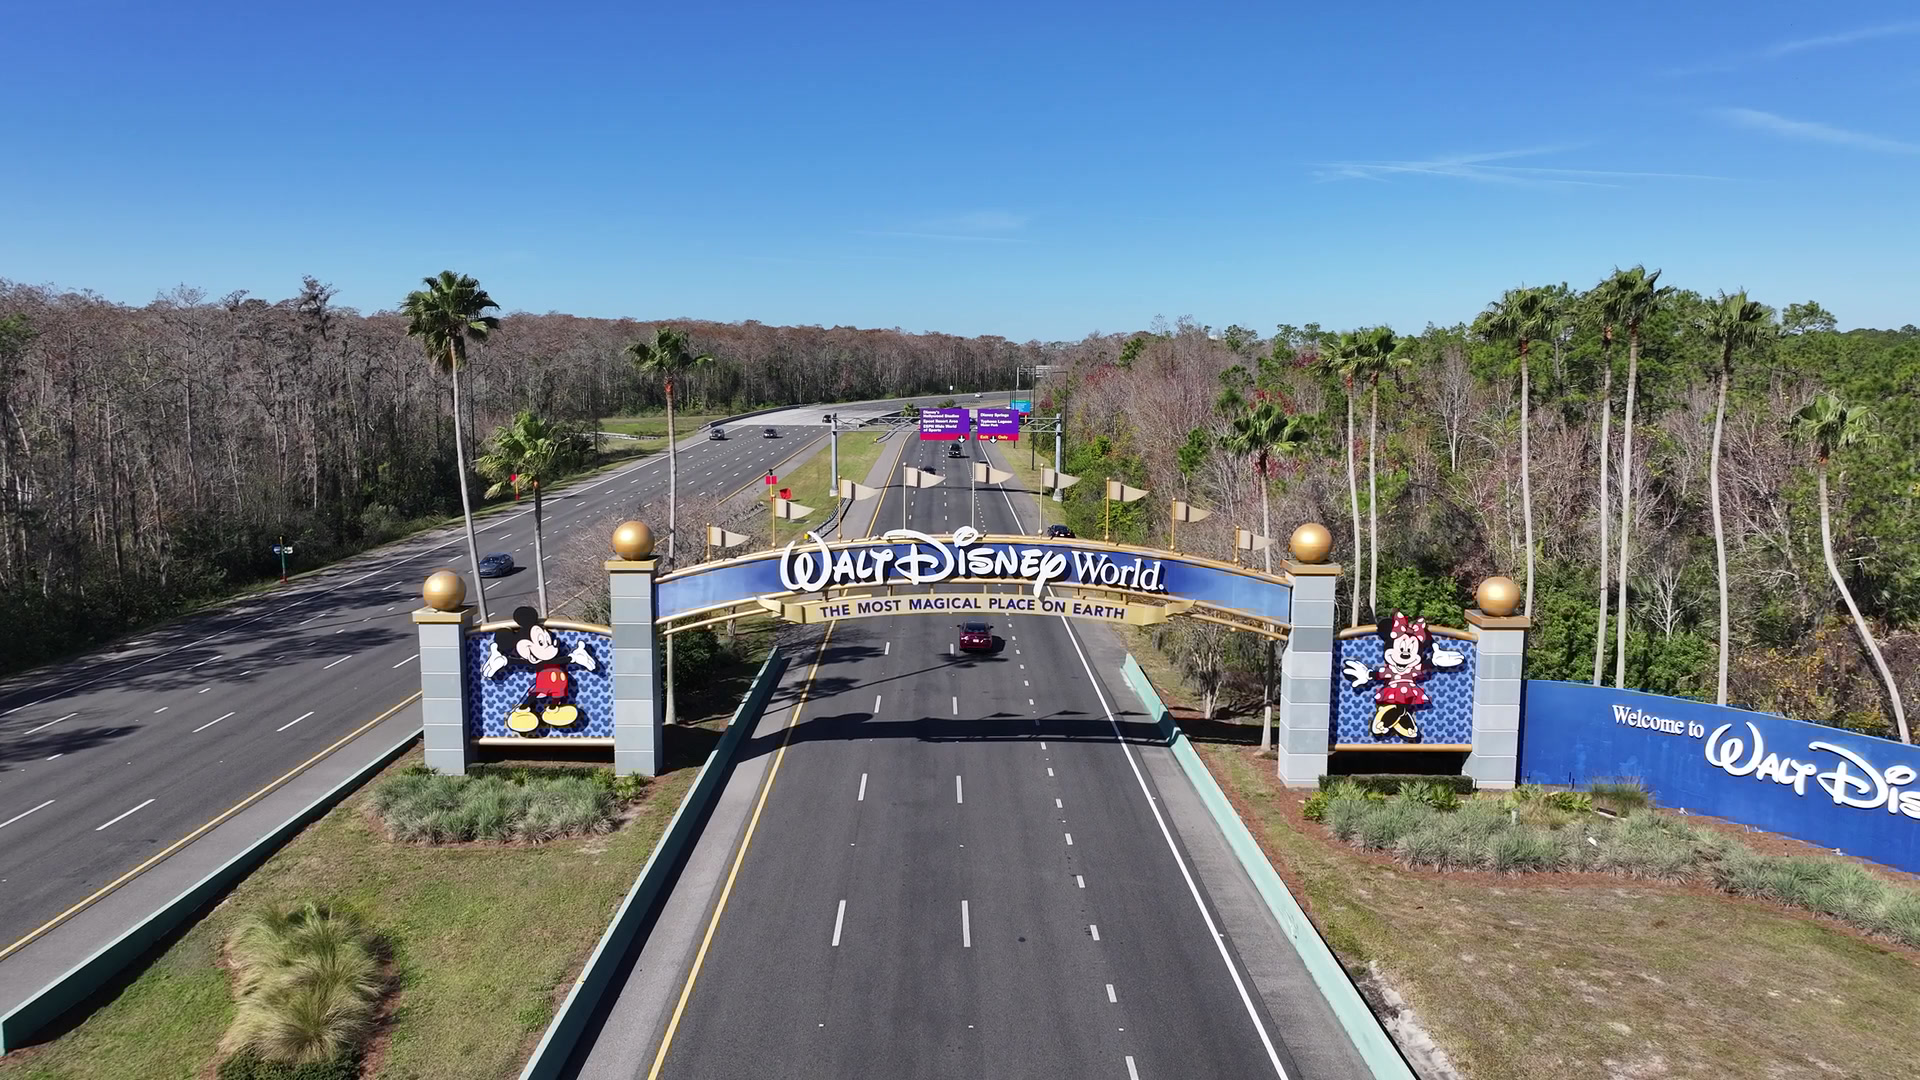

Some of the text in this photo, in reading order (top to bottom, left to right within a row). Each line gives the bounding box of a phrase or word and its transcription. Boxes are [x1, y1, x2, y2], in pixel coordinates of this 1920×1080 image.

[820, 597, 1125, 620] THE MOST MAGICAL PLACE ON EARTH
[1612, 704, 1685, 735] Welcome
[1688, 723, 1704, 739] to
